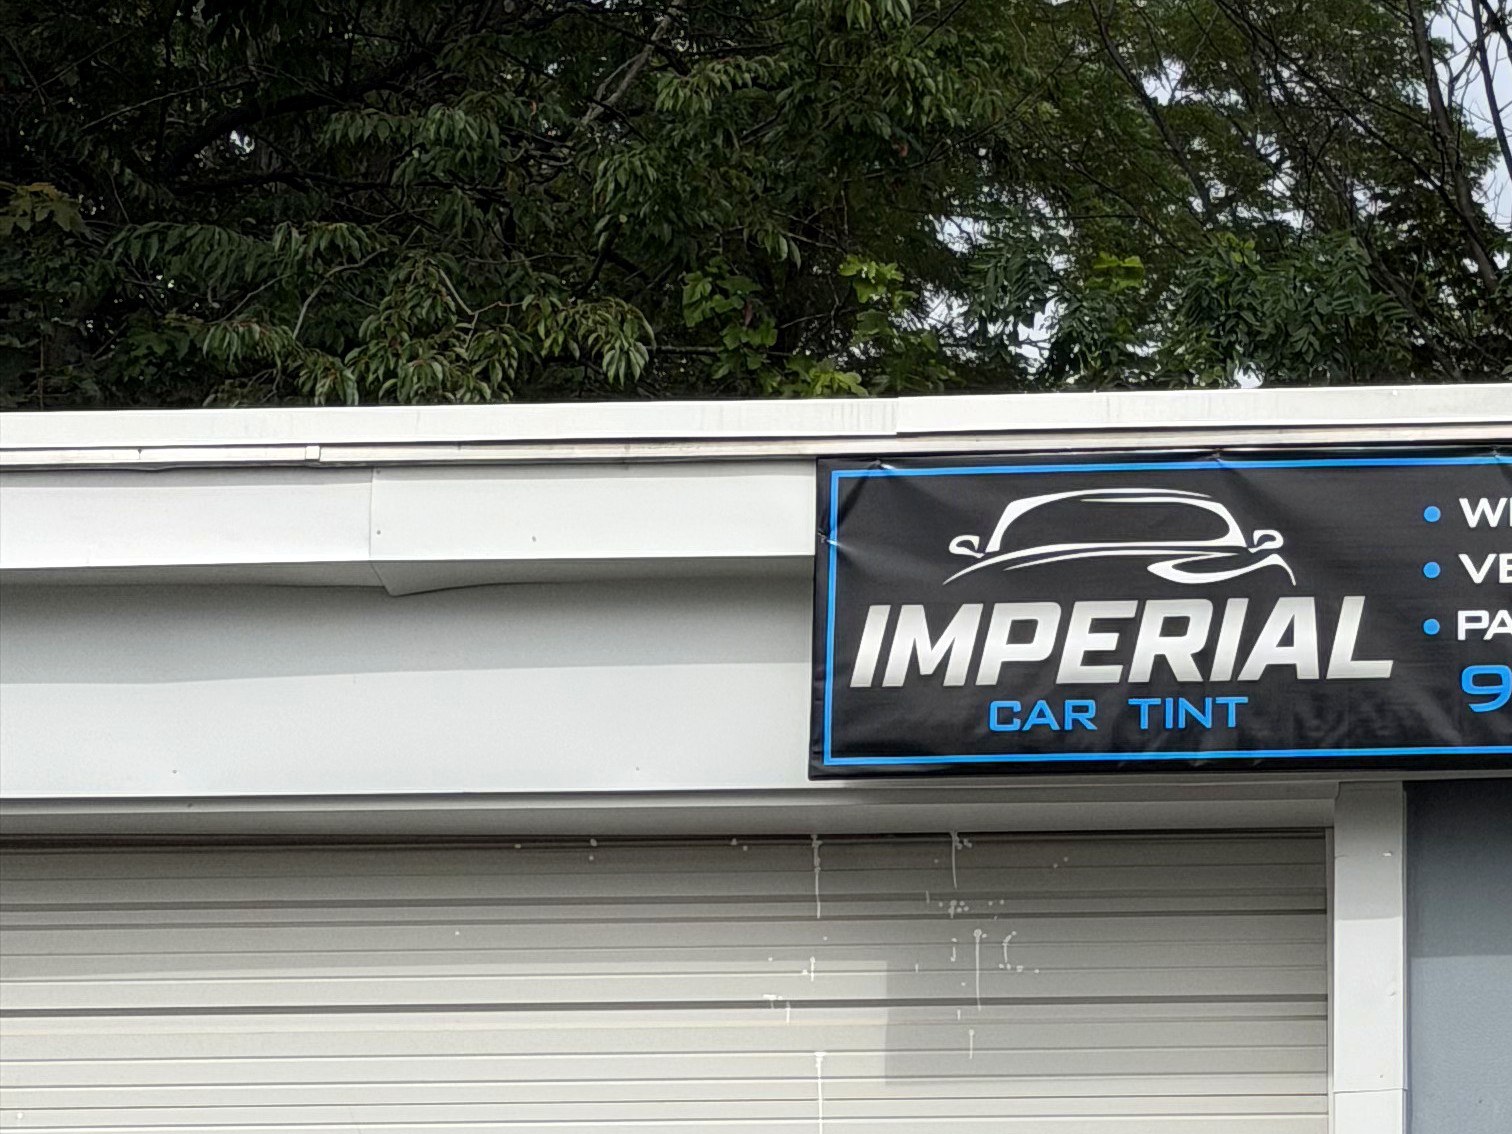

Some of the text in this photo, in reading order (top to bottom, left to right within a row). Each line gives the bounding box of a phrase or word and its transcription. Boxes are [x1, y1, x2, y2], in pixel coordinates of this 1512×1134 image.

[850, 596, 1394, 687] IMPERIAL
[989, 696, 1249, 731] CAR TINT
